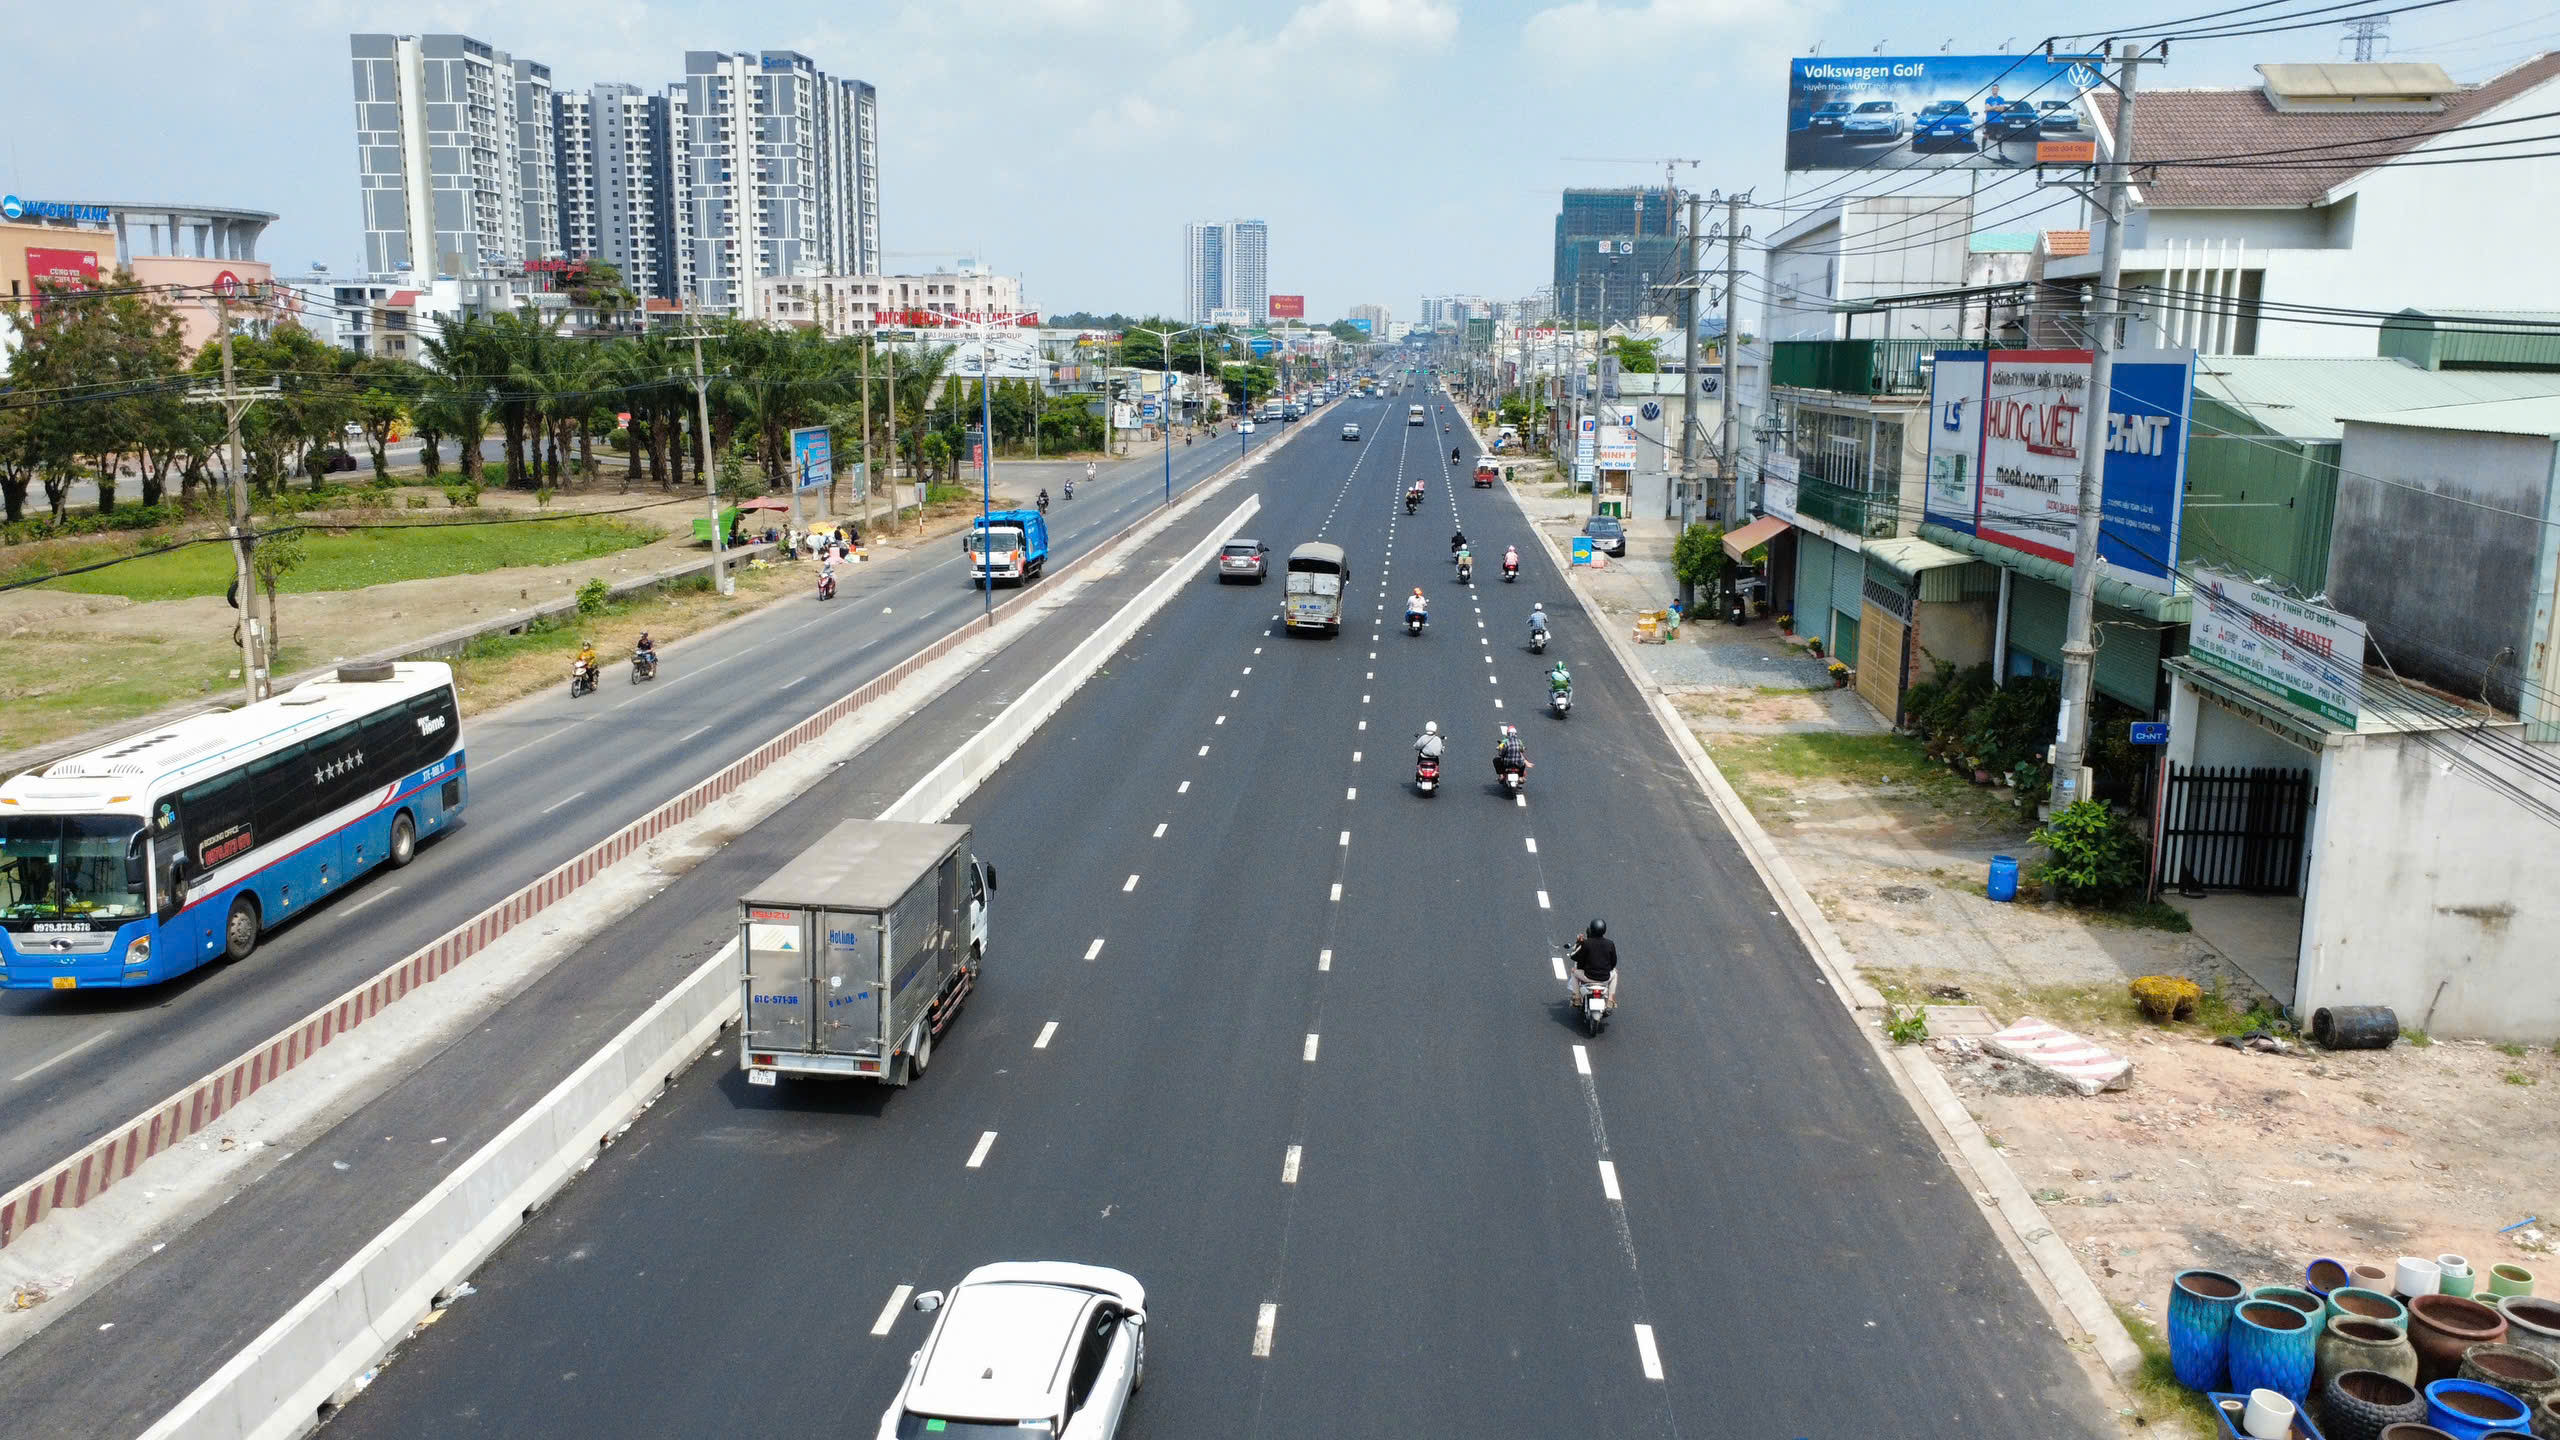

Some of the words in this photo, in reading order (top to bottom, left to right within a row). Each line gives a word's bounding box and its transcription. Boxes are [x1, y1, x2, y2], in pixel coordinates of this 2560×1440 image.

[1804, 64, 1889, 80] Volkswagen
[1893, 63, 1925, 77] Golf
[22, 200, 72, 217] WOORI
[73, 206, 111, 221] BANK
[1600, 451, 1626, 459] MINH
[2251, 591, 2270, 606] CÔNG
[2271, 598, 2281, 610] TY
[2282, 602, 2302, 616] TNHH
[203, 831, 224, 848] BOOKING
[752, 909, 791, 920] ISUZU
[33, 922, 91, 932] 0979.873.678
